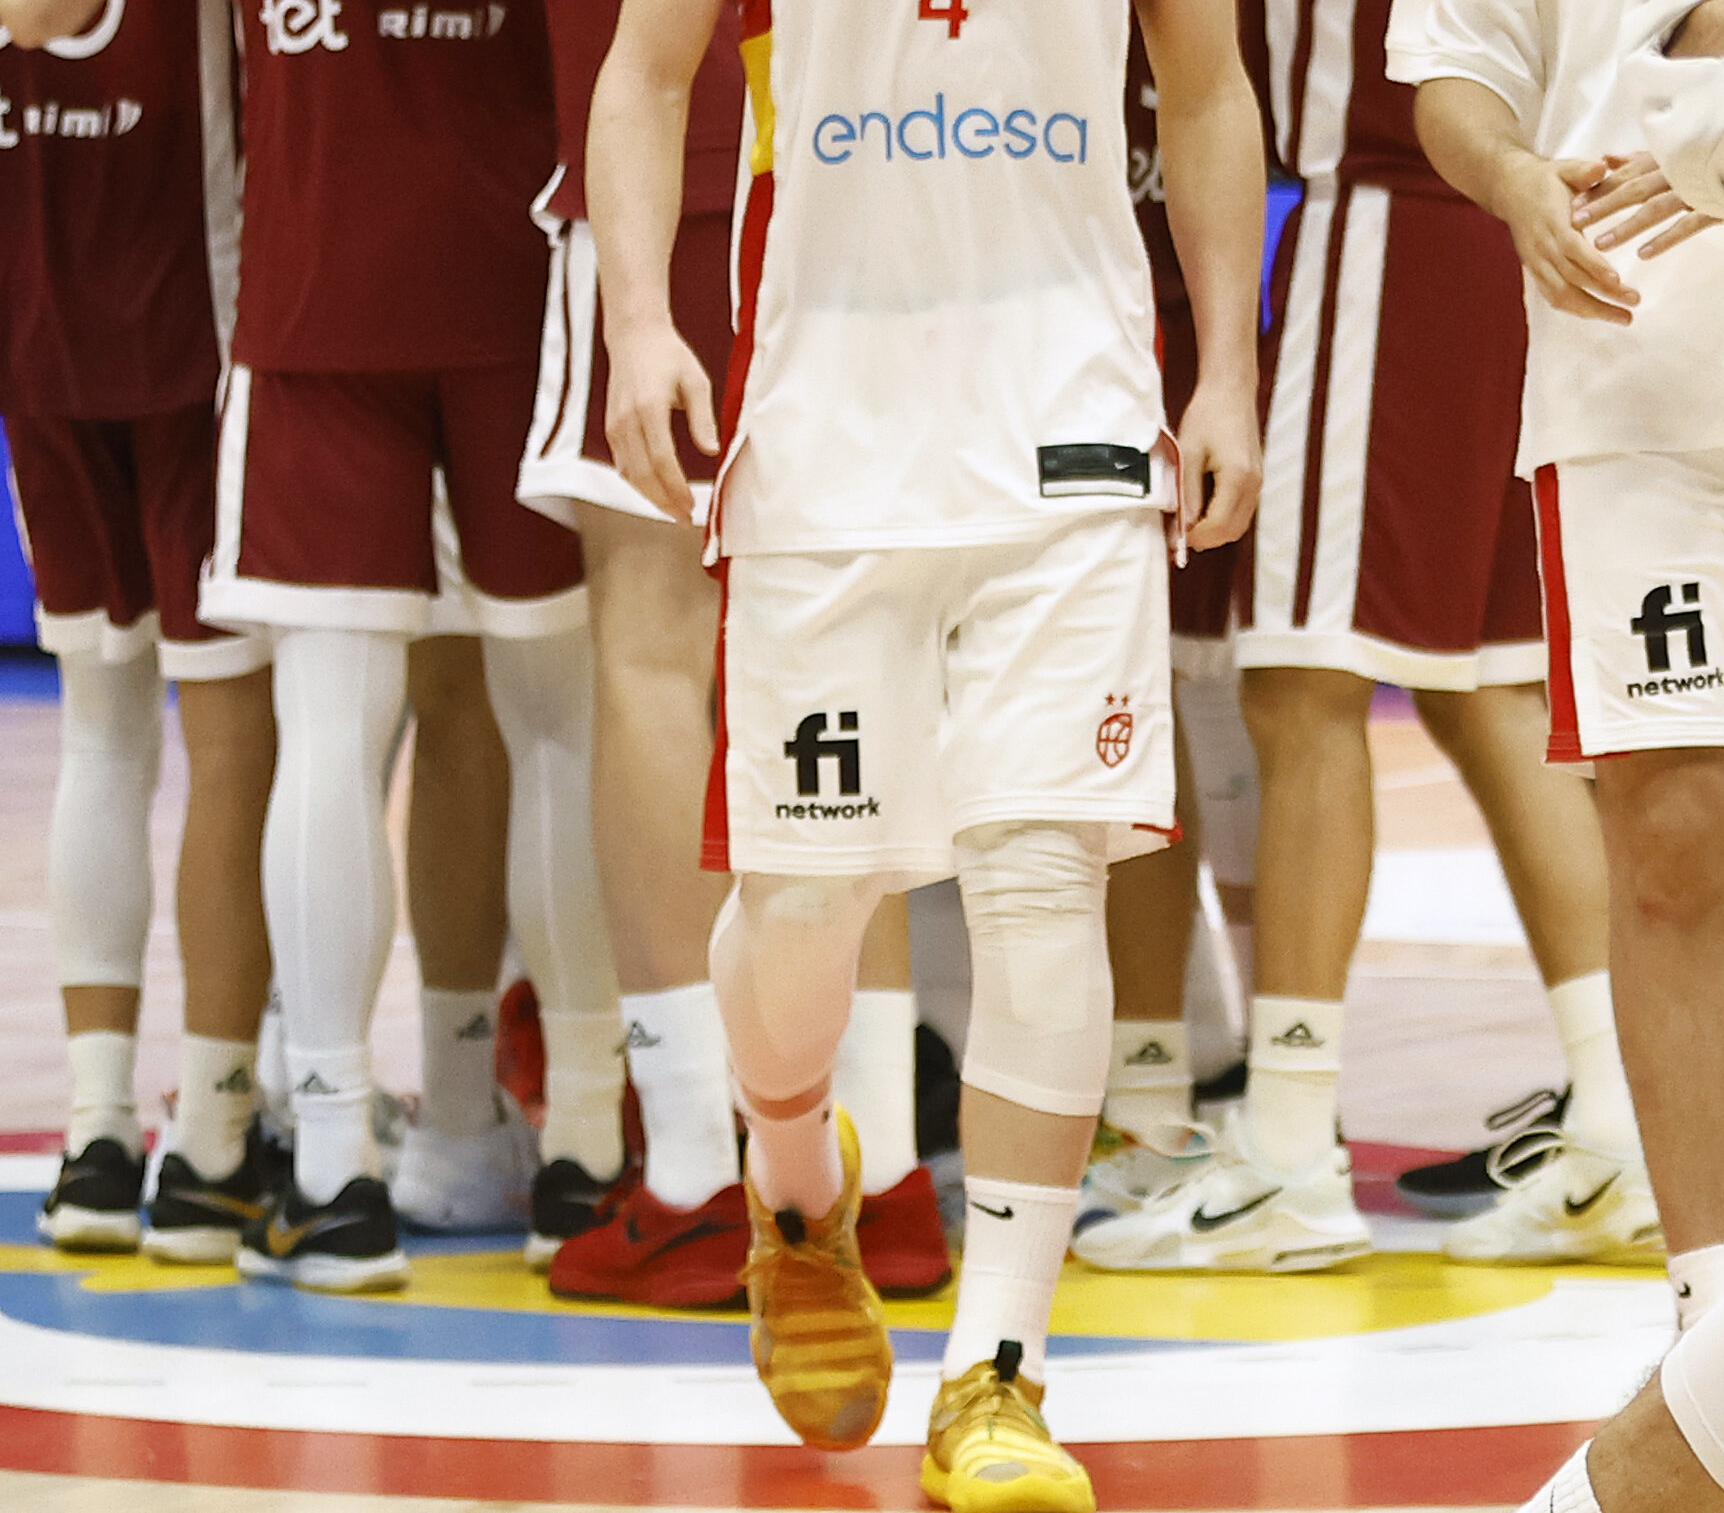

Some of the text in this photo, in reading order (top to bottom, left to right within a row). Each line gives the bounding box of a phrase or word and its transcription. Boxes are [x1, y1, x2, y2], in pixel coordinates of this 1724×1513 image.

[813, 92, 1088, 165] endesa
[1630, 582, 1707, 673] fi
[1627, 667, 1724, 698] network
[784, 711, 860, 796] fi
[775, 798, 880, 821] network
